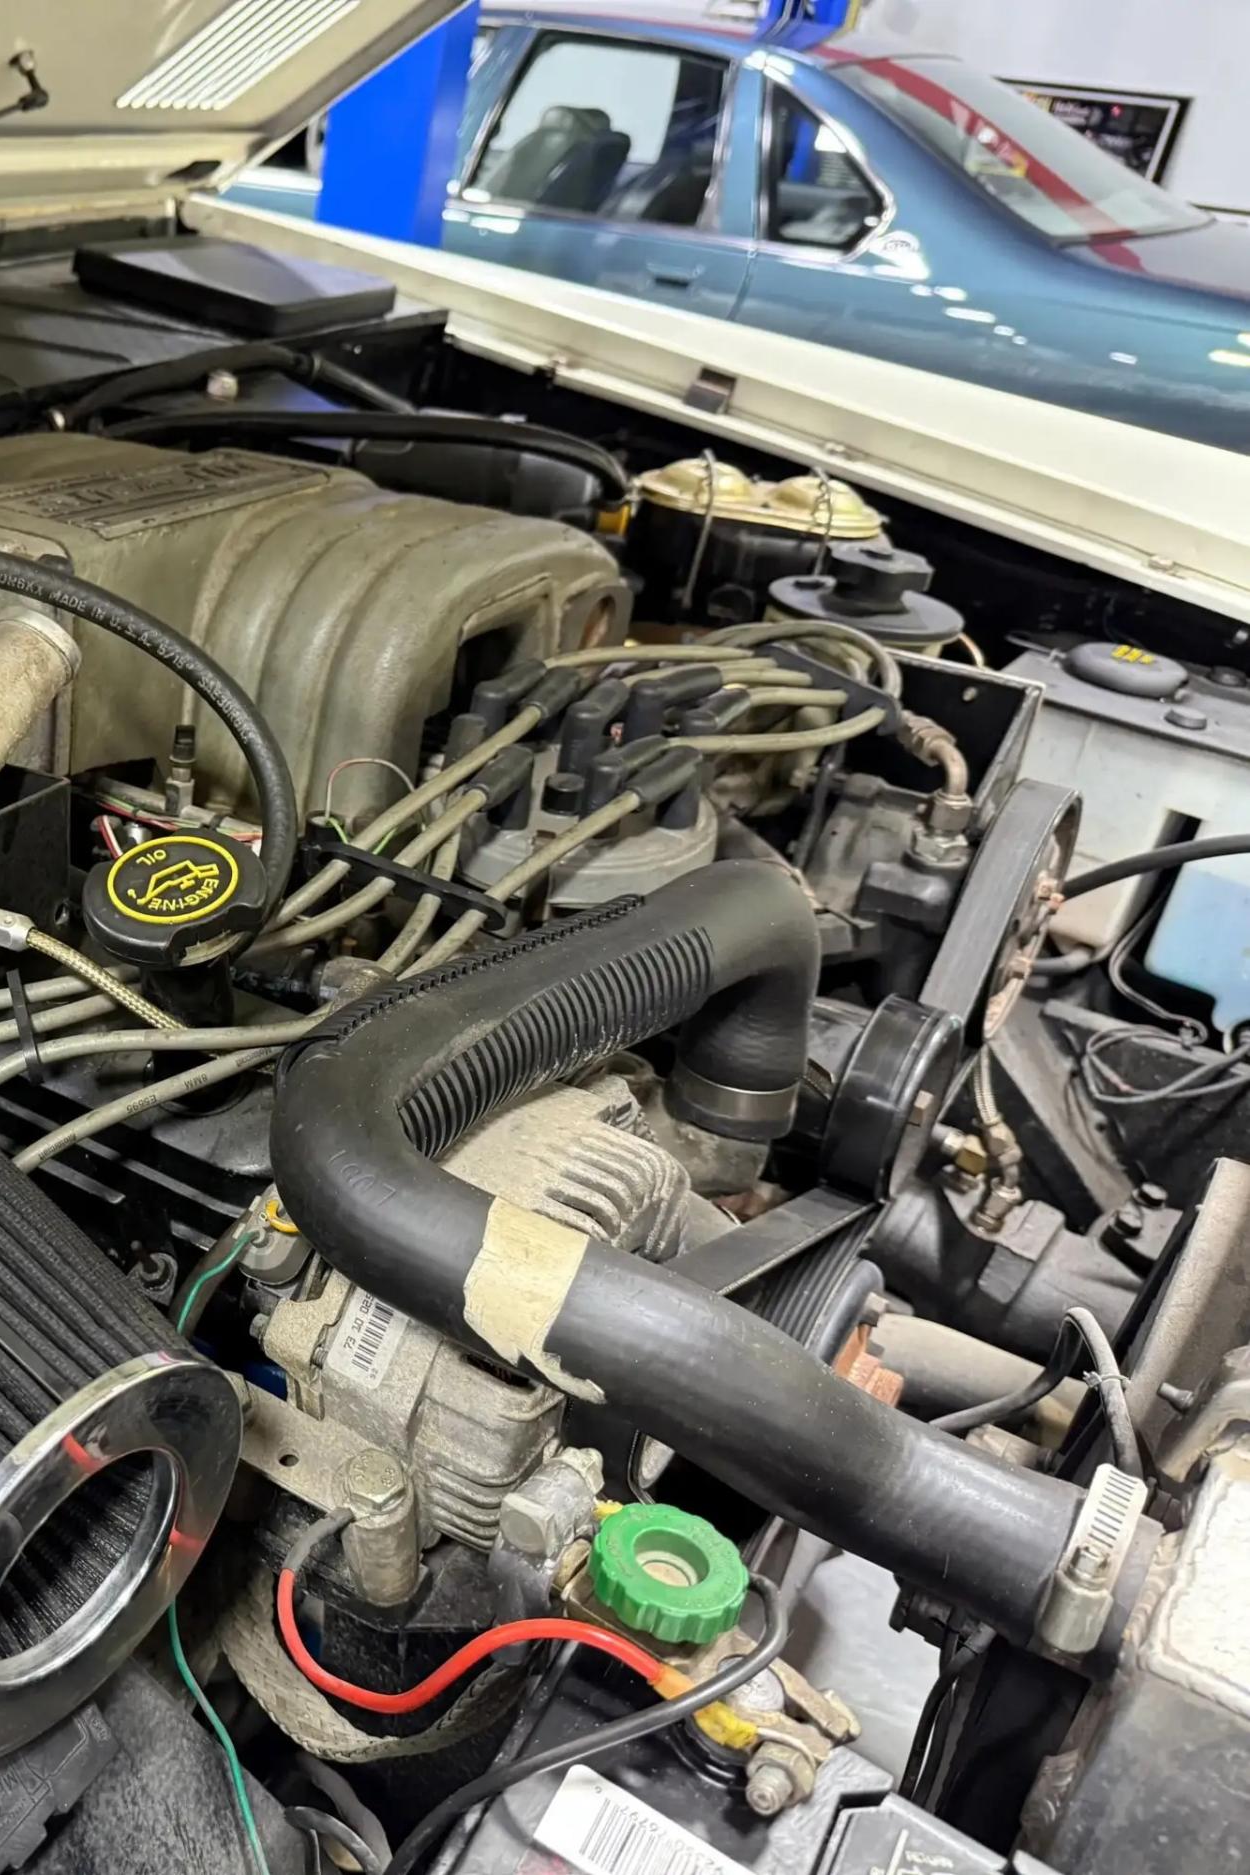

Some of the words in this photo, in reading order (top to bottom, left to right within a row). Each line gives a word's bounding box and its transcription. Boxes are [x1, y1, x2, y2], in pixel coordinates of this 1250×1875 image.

[48, 590, 87, 613] MADE
[91, 606, 104, 620] IN
[136, 849, 167, 867] OIL
[148, 878, 220, 911] ENGINE
